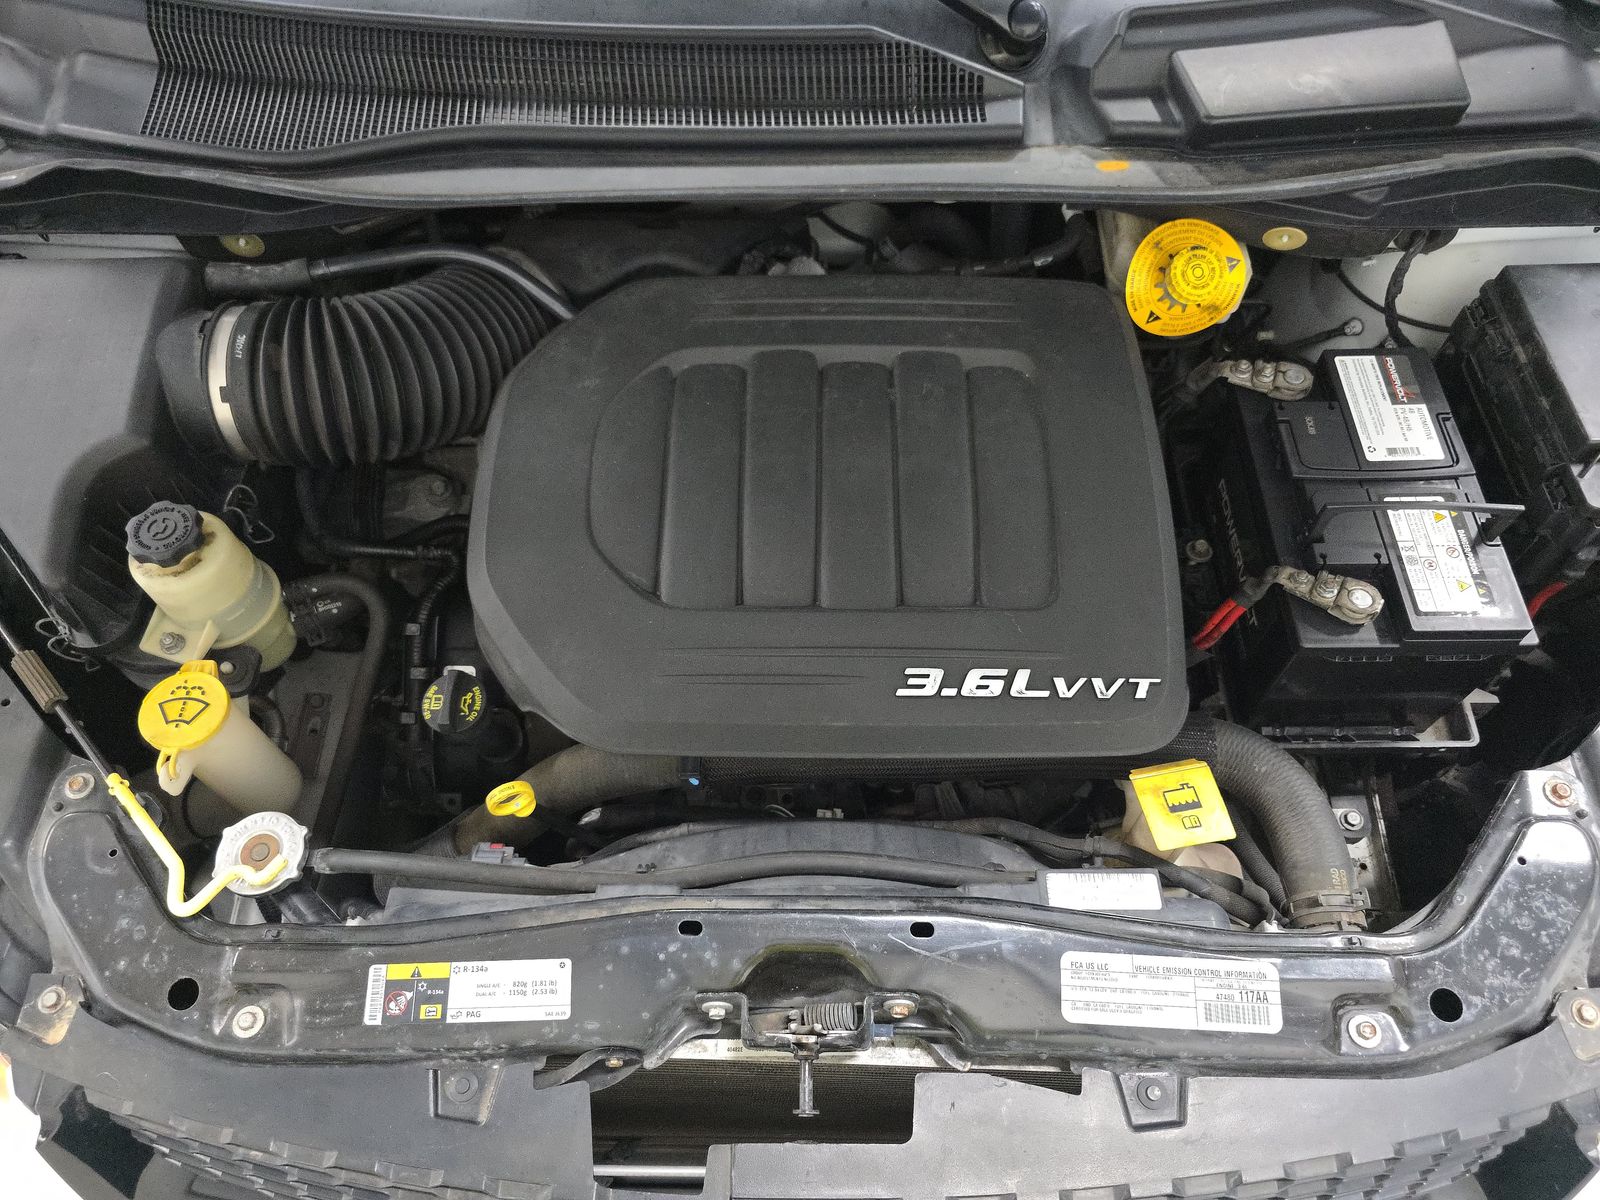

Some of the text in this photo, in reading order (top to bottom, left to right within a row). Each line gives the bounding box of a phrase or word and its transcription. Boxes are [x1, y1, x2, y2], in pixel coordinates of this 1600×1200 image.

[1384, 356, 1408, 403] POWERVOLT
[1416, 408, 1434, 441] AUTOMOTIVE
[1457, 530, 1479, 575] DANGER/POISON
[426, 685, 438, 698] SAE
[895, 667, 1162, 699] 3.6L VVT
[466, 686, 483, 722] ENGINE OIL
[1070, 961, 1109, 971] FCA US LLC
[1135, 965, 1267, 980] VEHICLE EMISSION CONTROL INFORMATION
[1239, 991, 1268, 1003] 117AA
